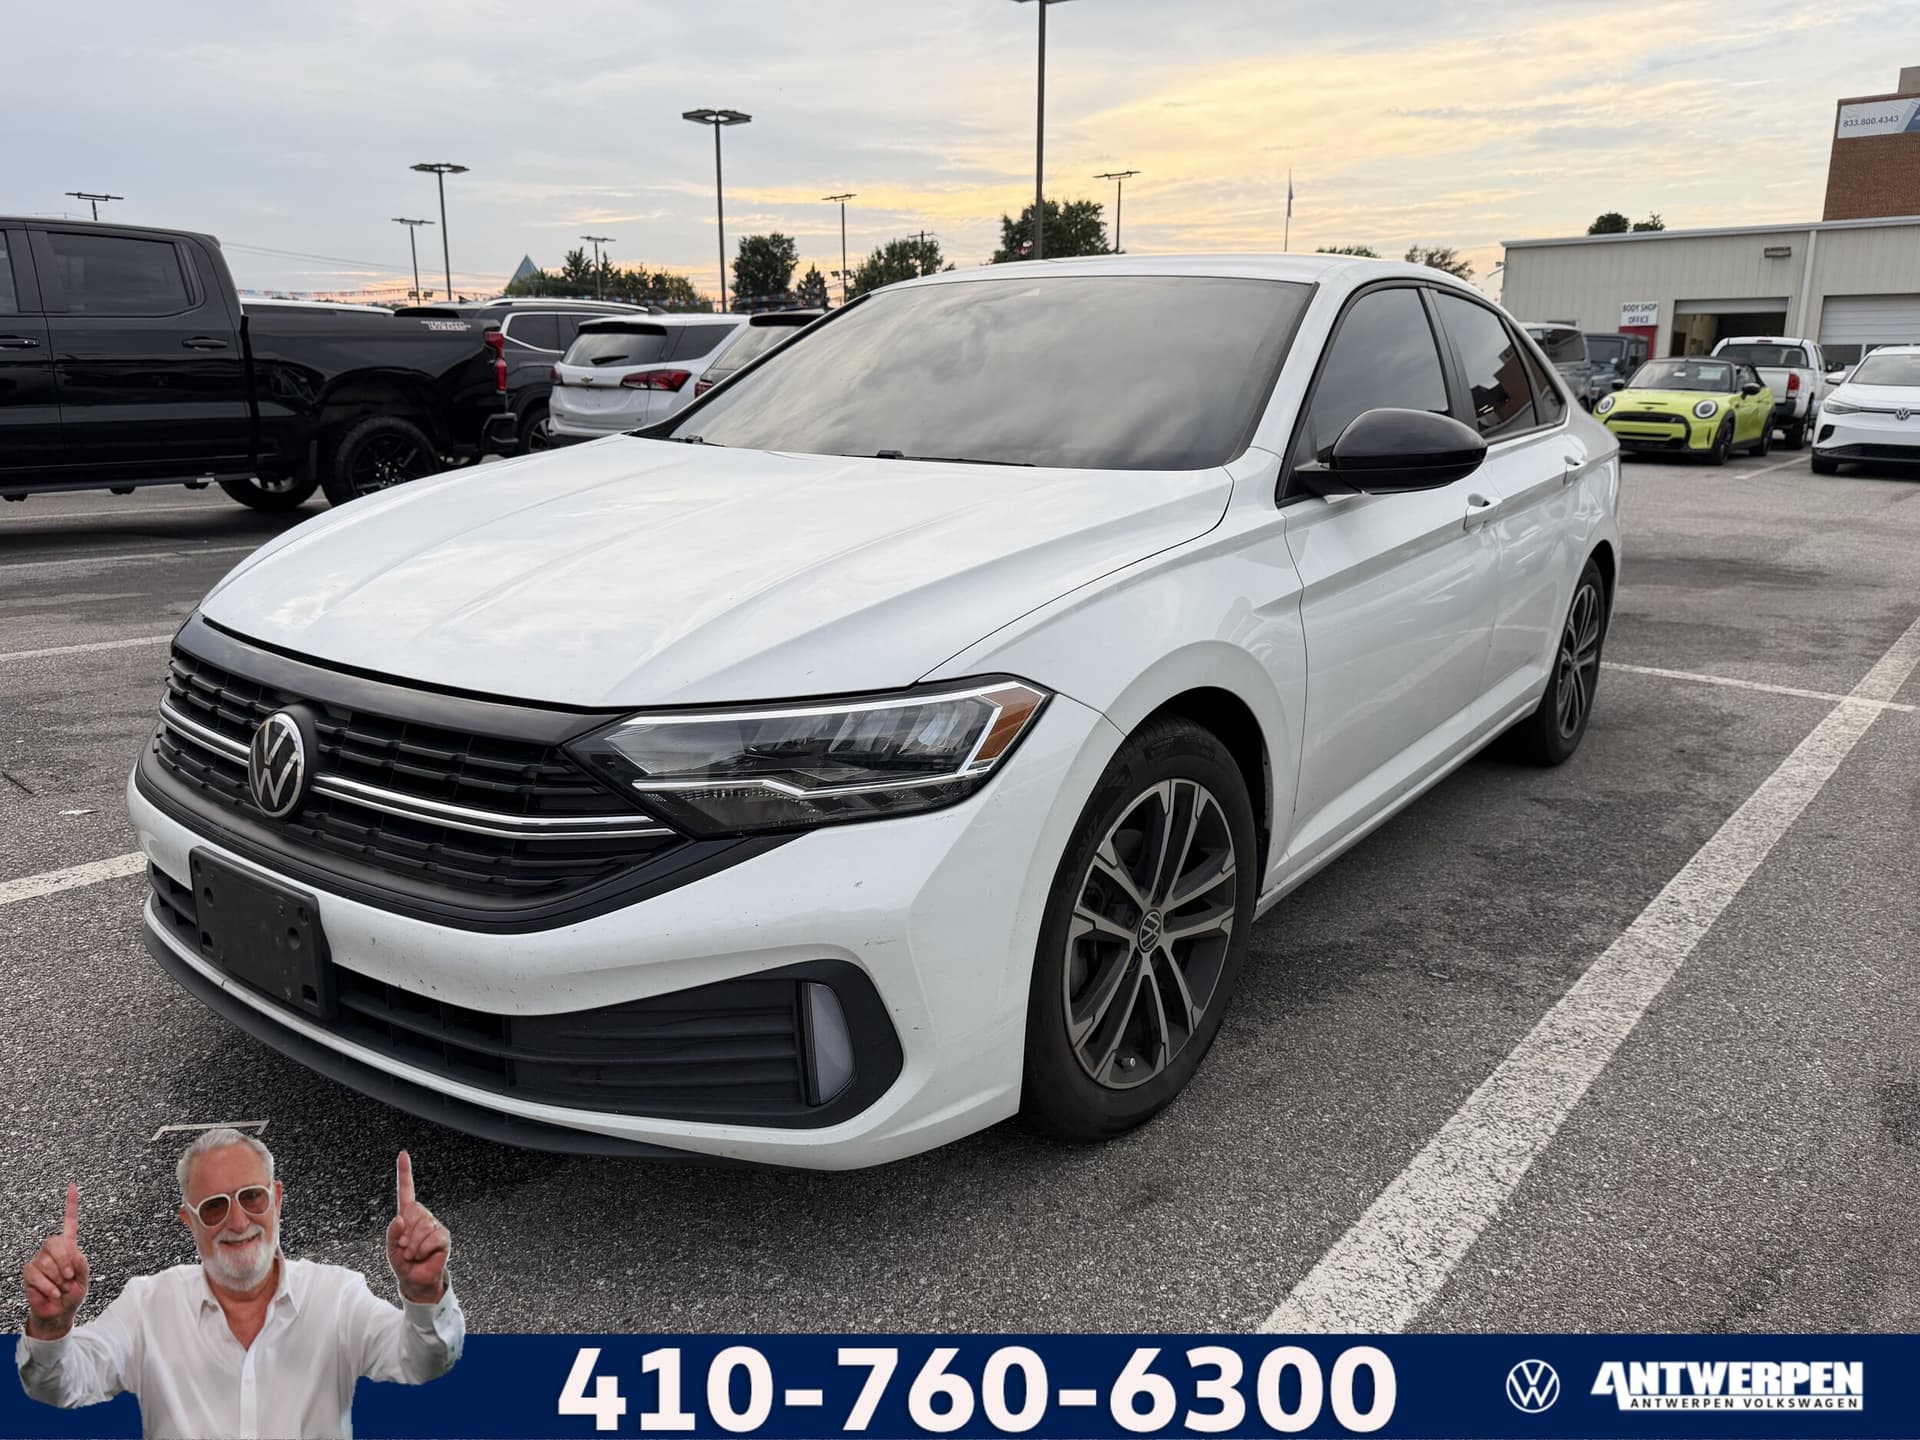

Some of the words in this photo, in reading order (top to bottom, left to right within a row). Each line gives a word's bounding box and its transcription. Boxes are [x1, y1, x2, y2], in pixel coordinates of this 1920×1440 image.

[1623, 303, 1639, 312] BODY
[1641, 303, 1657, 312] SHOP
[1628, 315, 1649, 323] OFFICE
[248, 712, 305, 817] VW
